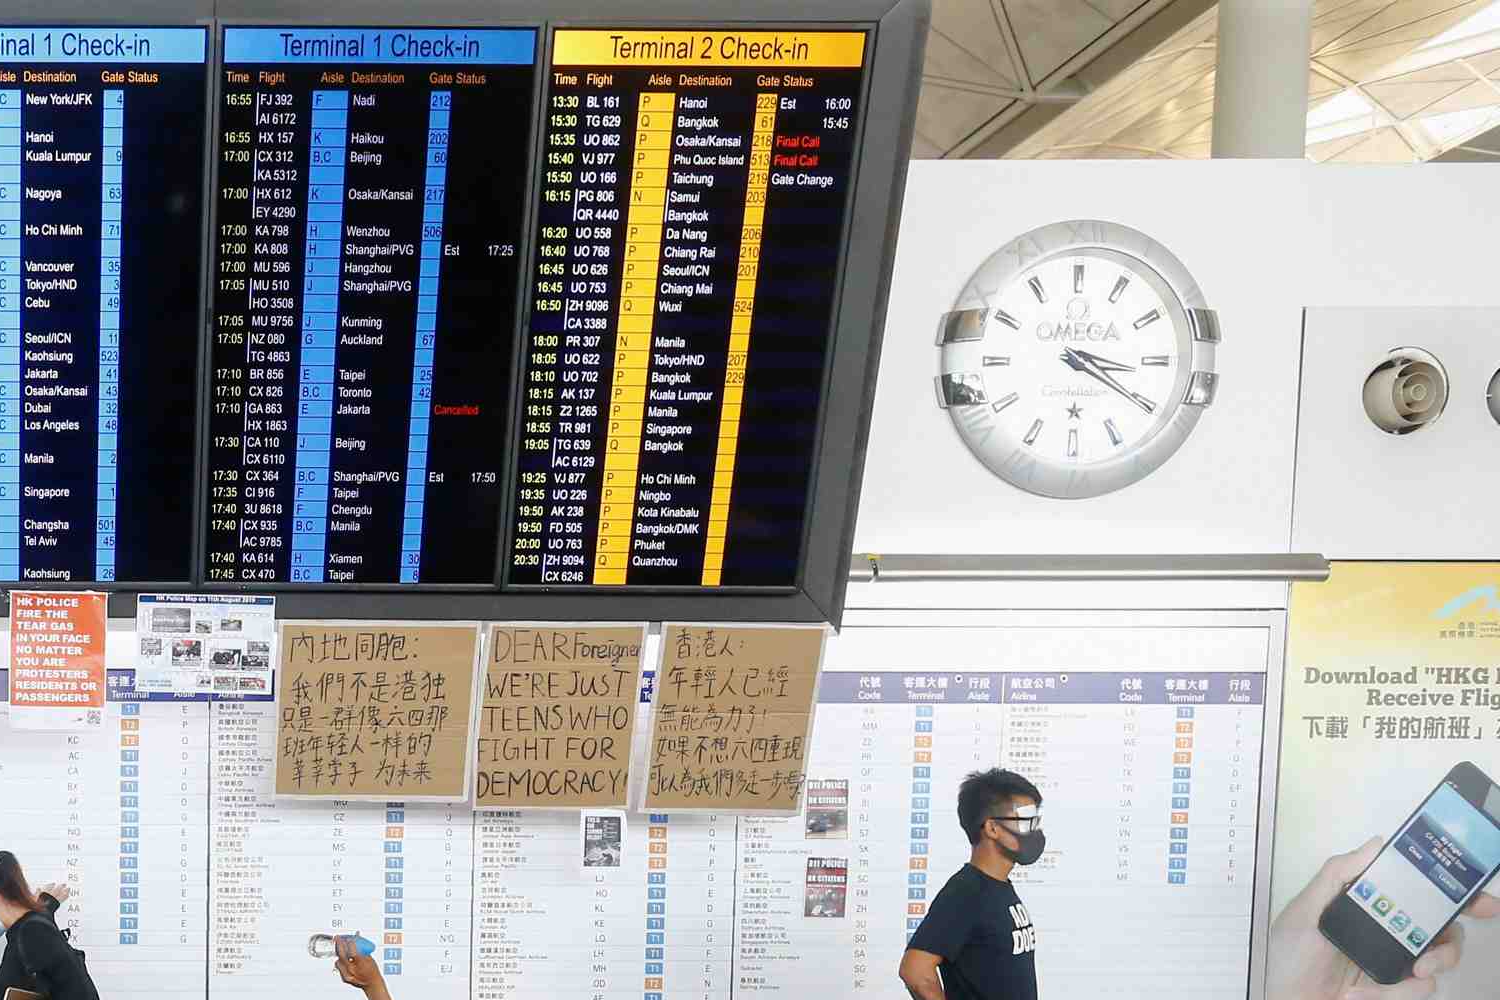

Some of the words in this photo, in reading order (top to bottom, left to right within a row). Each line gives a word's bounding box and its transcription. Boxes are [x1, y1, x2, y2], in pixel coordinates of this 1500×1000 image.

[44, 33, 51, 56] 1
[61, 33, 151, 56] Check-in
[280, 34, 364, 57] Terminal
[373, 34, 381, 57] 1
[391, 34, 480, 57] Check-in
[611, 35, 693, 59] Terminal
[700, 37, 712, 59] 2
[720, 36, 809, 60] Check-in
[26, 94, 44, 104] New
[47, 94, 92, 105] York/JFK
[116, 94, 122, 104] 4
[552, 96, 579, 108] 13:30
[587, 97, 600, 107] BL
[603, 97, 620, 108] 161
[642, 96, 651, 107] P
[679, 98, 708, 109] Hanoi
[756, 97, 777, 109] 229
[780, 98, 796, 109] Est
[824, 98, 851, 110] 16:00
[224, 133, 250, 143] 16:55
[258, 132, 273, 143] HX
[276, 133, 294, 143] 157
[314, 133, 322, 144] K
[351, 133, 384, 144] Haikou
[430, 133, 448, 145] 202
[1036, 322, 1121, 341] OMEGA
[17, 598, 33, 607] HK
[36, 598, 79, 607] POLICE
[16, 609, 41, 618] FIRE
[45, 610, 68, 618] THE
[16, 621, 46, 630] TEAR
[50, 622, 74, 631] GAS
[16, 633, 27, 642] IN
[28, 634, 60, 643] YOUR
[62, 634, 91, 643] FACE
[16, 646, 32, 654] NO
[36, 646, 83, 655] MATTER
[494, 630, 571, 663] DEAR
[16, 657, 39, 666] YOU
[42, 658, 68, 666] ARE
[16, 669, 89, 679] PROTESTERS
[1304, 666, 1418, 684] Download
[1425, 666, 1490, 684] "HKG
[15, 681, 78, 690] RESIDENTS
[81, 682, 97, 691] OR
[486, 671, 560, 699] WE'RE
[15, 692, 90, 702] PASSENGERS
[1119, 692, 1142, 702] Code
[1168, 693, 1205, 702] Terminal
[1366, 688, 1455, 706] Receive
[483, 704, 563, 732] TEENS
[569, 705, 628, 730] WHO
[1302, 716, 1500, 739] 下載「我的航班」
[477, 737, 556, 762] FIGHT
[565, 736, 617, 760] FOR
[476, 769, 629, 799] DEMOCRACY!
